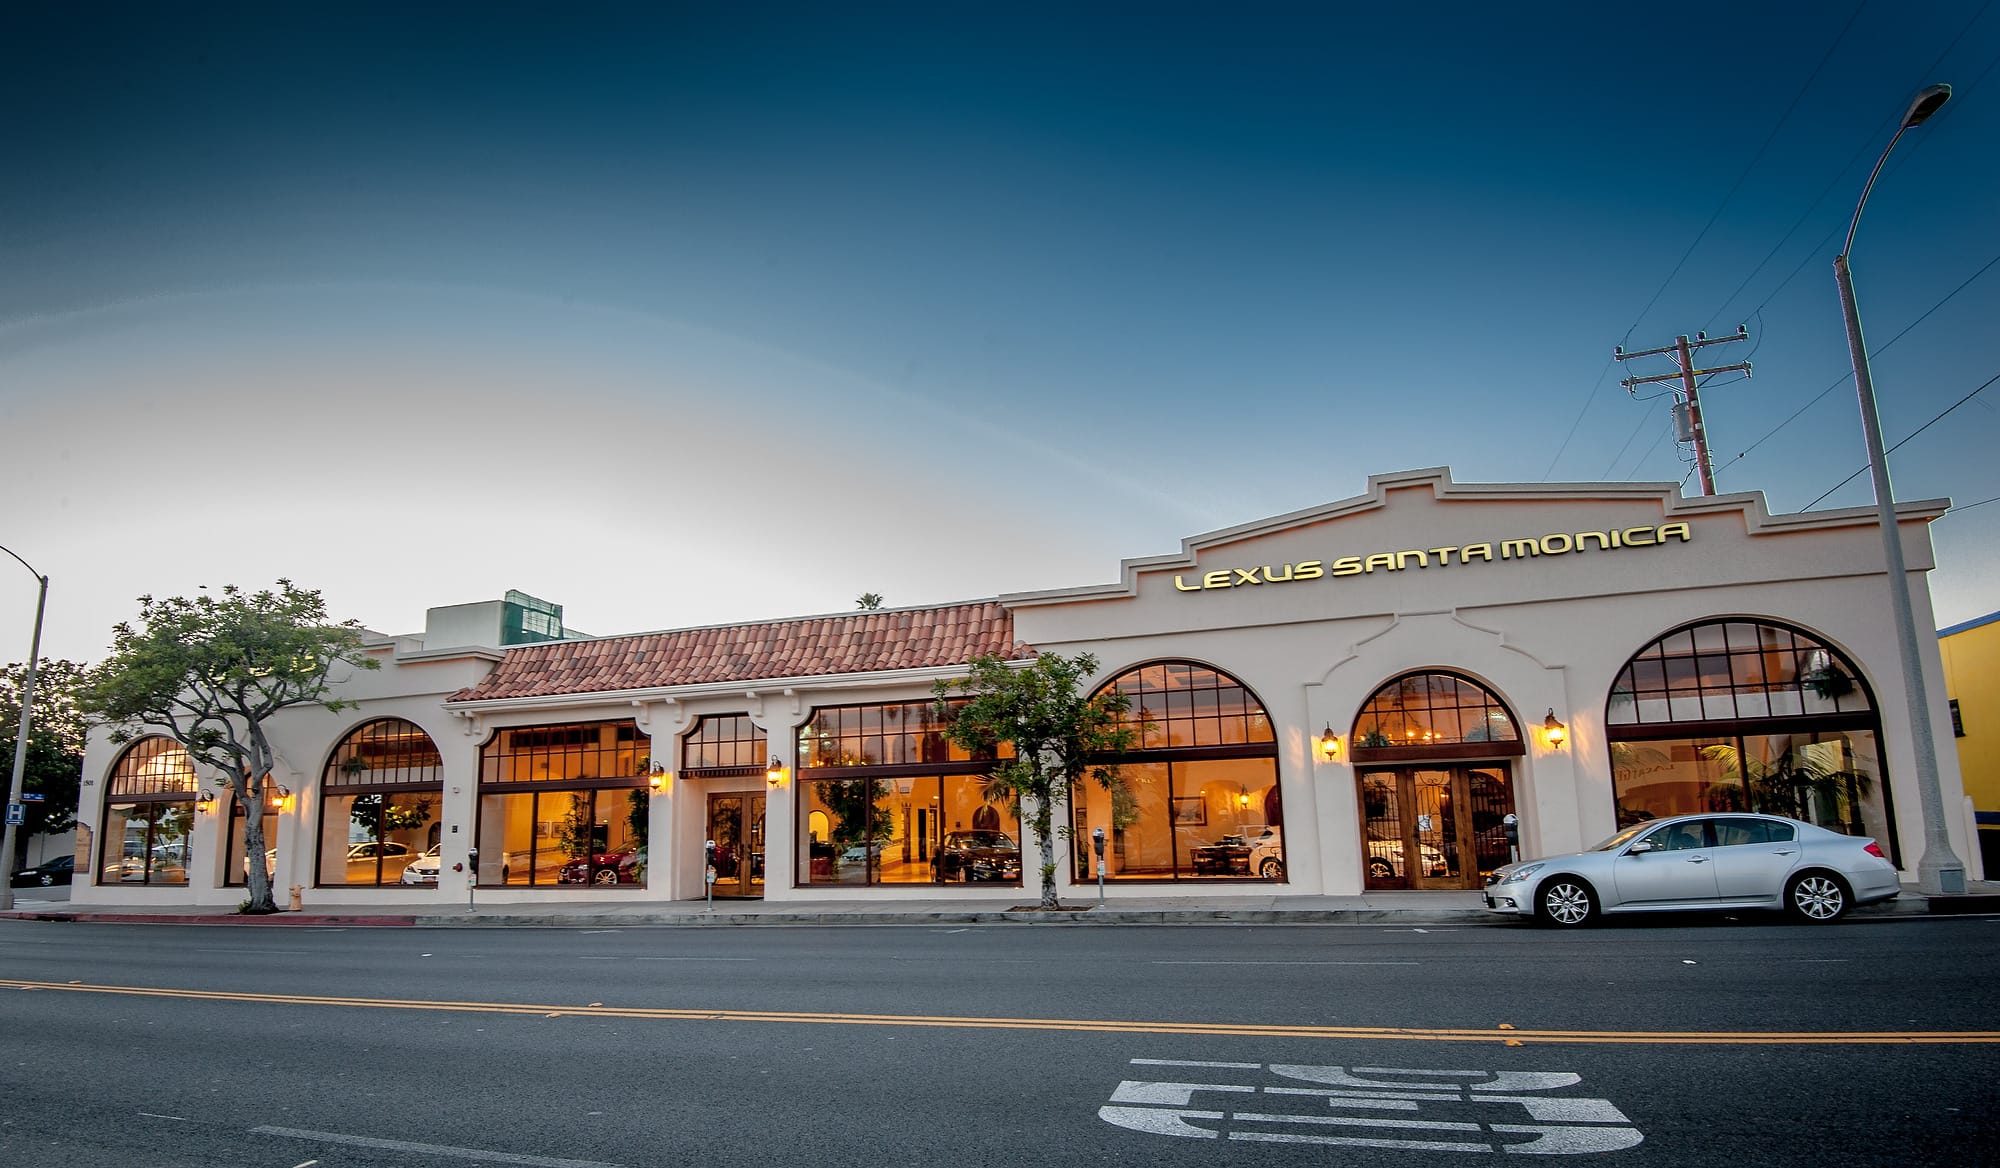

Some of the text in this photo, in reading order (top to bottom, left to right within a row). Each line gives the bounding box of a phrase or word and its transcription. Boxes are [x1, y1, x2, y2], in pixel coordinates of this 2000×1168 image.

[1174, 522, 1691, 592] LEXUS SANTA MONICA
[8, 805, 23, 820] H
[1098, 1057, 1645, 1155] PED
